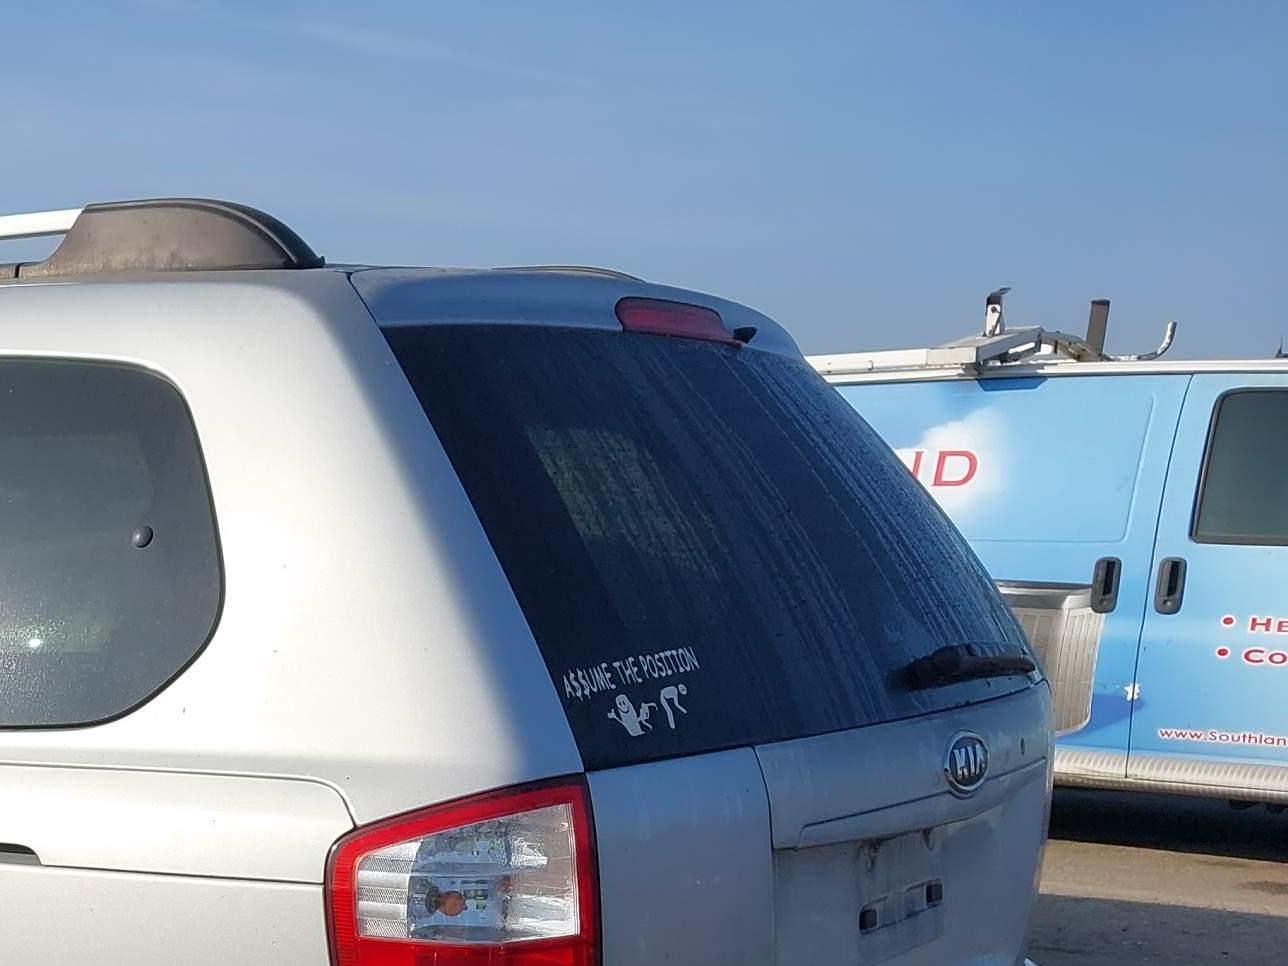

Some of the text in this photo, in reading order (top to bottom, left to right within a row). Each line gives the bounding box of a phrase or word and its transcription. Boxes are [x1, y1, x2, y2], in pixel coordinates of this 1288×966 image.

[612, 656, 643, 685] THE
[638, 646, 701, 680] POSITION
[953, 744, 986, 781] KIA
